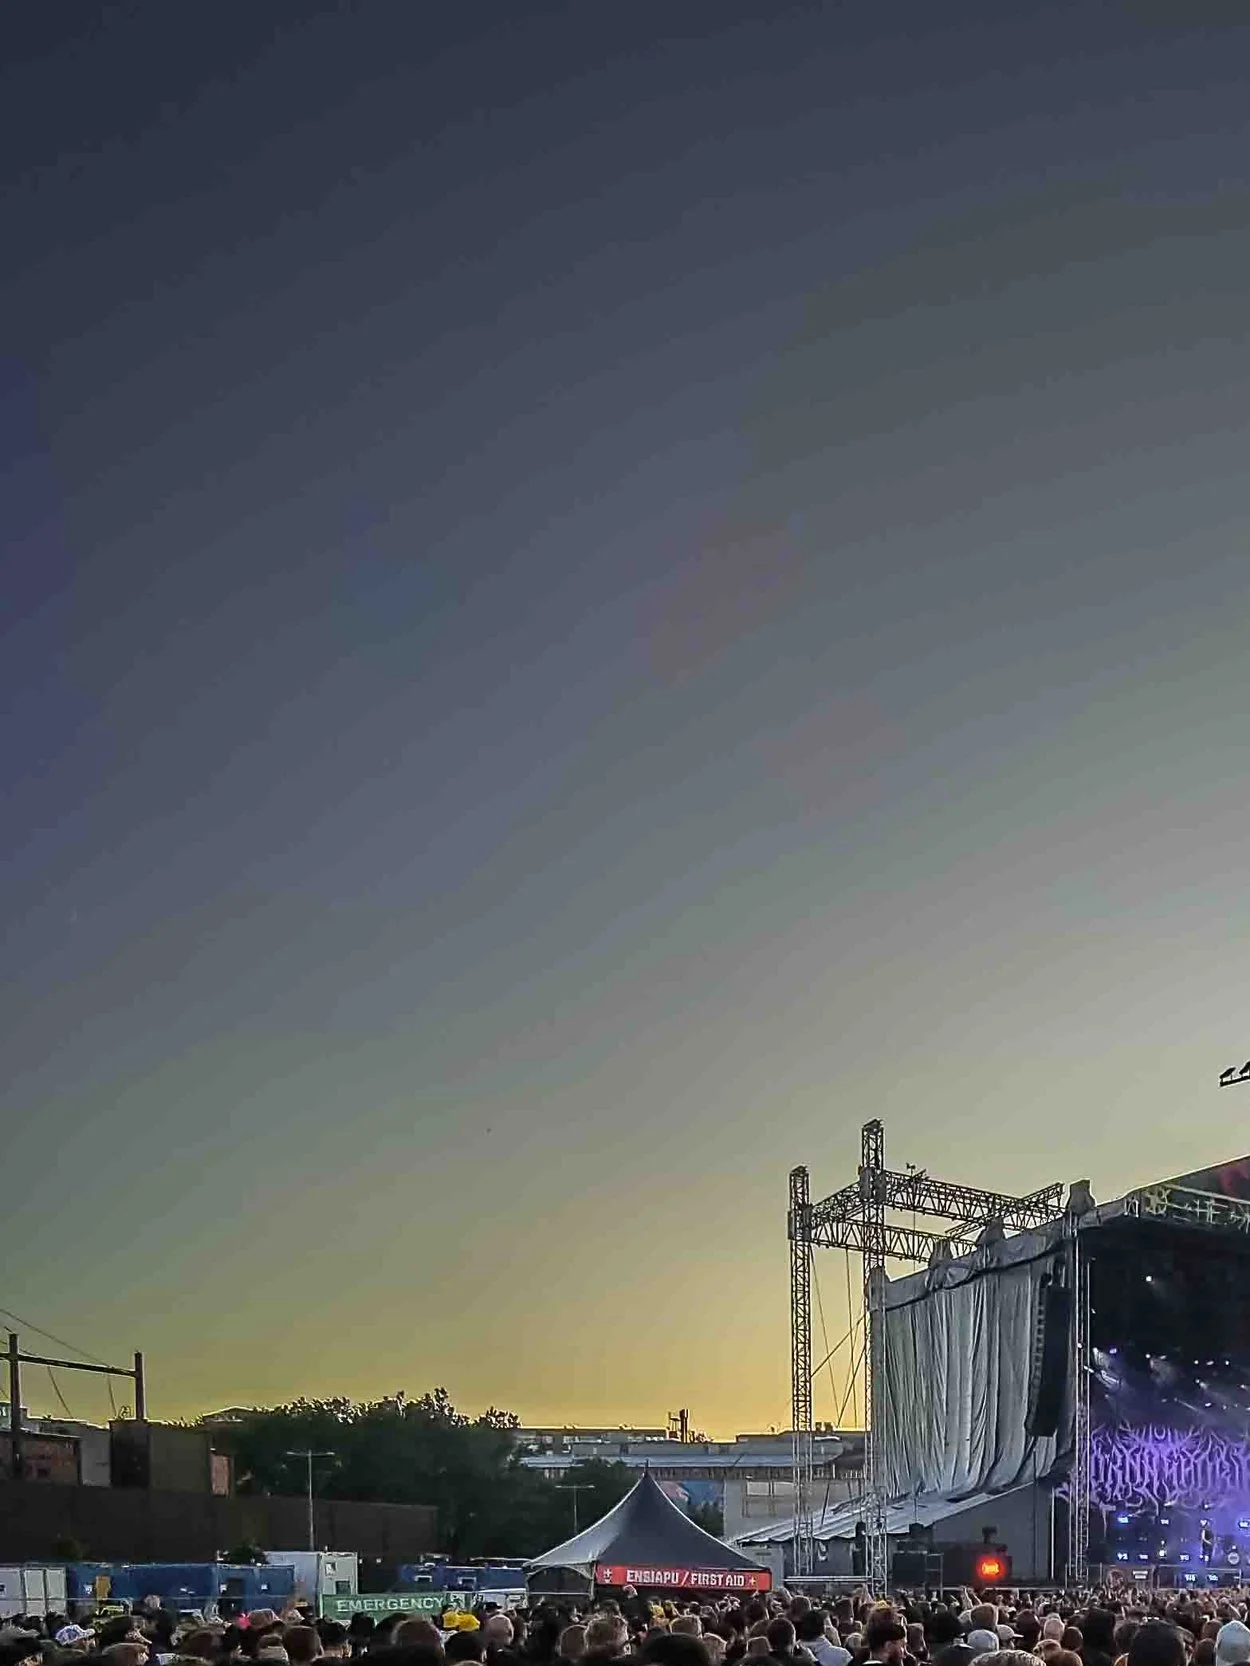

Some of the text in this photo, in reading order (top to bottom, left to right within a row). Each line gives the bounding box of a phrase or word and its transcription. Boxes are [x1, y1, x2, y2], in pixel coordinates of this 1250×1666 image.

[626, 1569, 679, 1584] ENSIAPU
[690, 1573, 724, 1586] FIRST
[725, 1575, 745, 1587] AID
[336, 1596, 445, 1612] EMERGENCY
